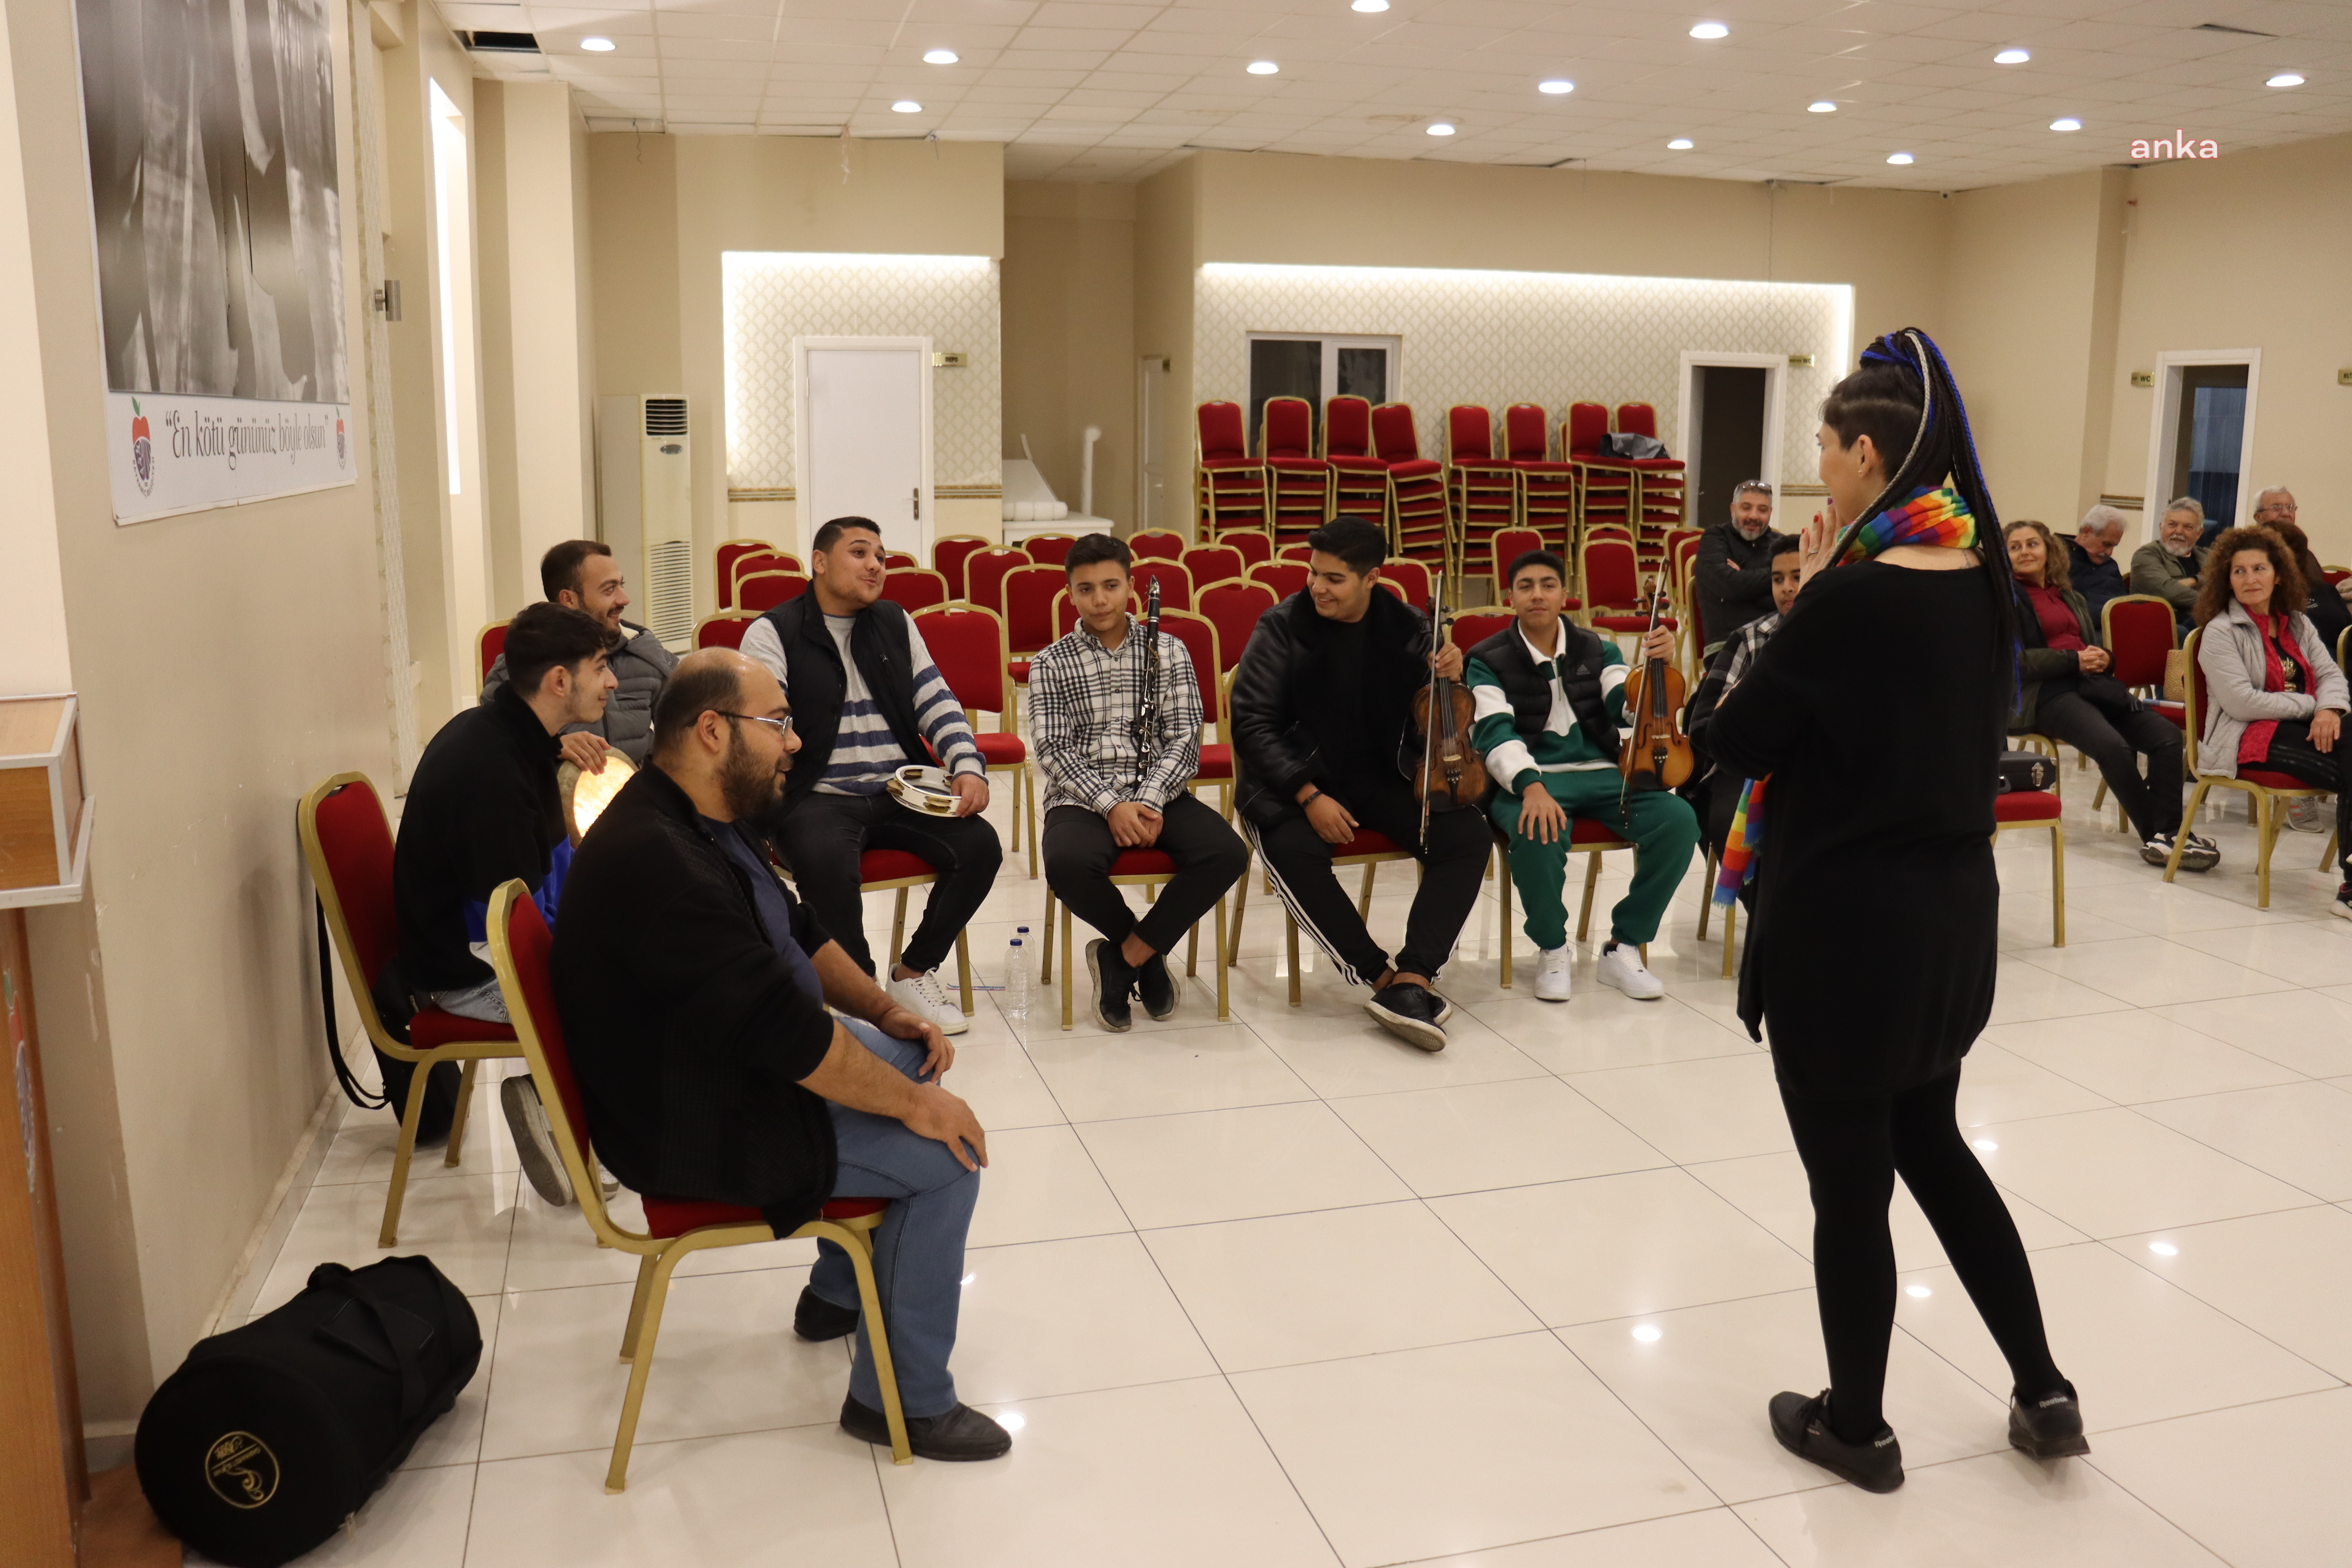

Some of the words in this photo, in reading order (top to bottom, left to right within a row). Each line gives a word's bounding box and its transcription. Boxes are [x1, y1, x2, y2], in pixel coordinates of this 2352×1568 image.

[194, 410, 225, 457] kötü
[229, 417, 276, 470] gününüz
[278, 412, 302, 465] böyle
[2039, 1396, 2068, 1408] Reebok
[1874, 1435, 1896, 1448] Reebo
